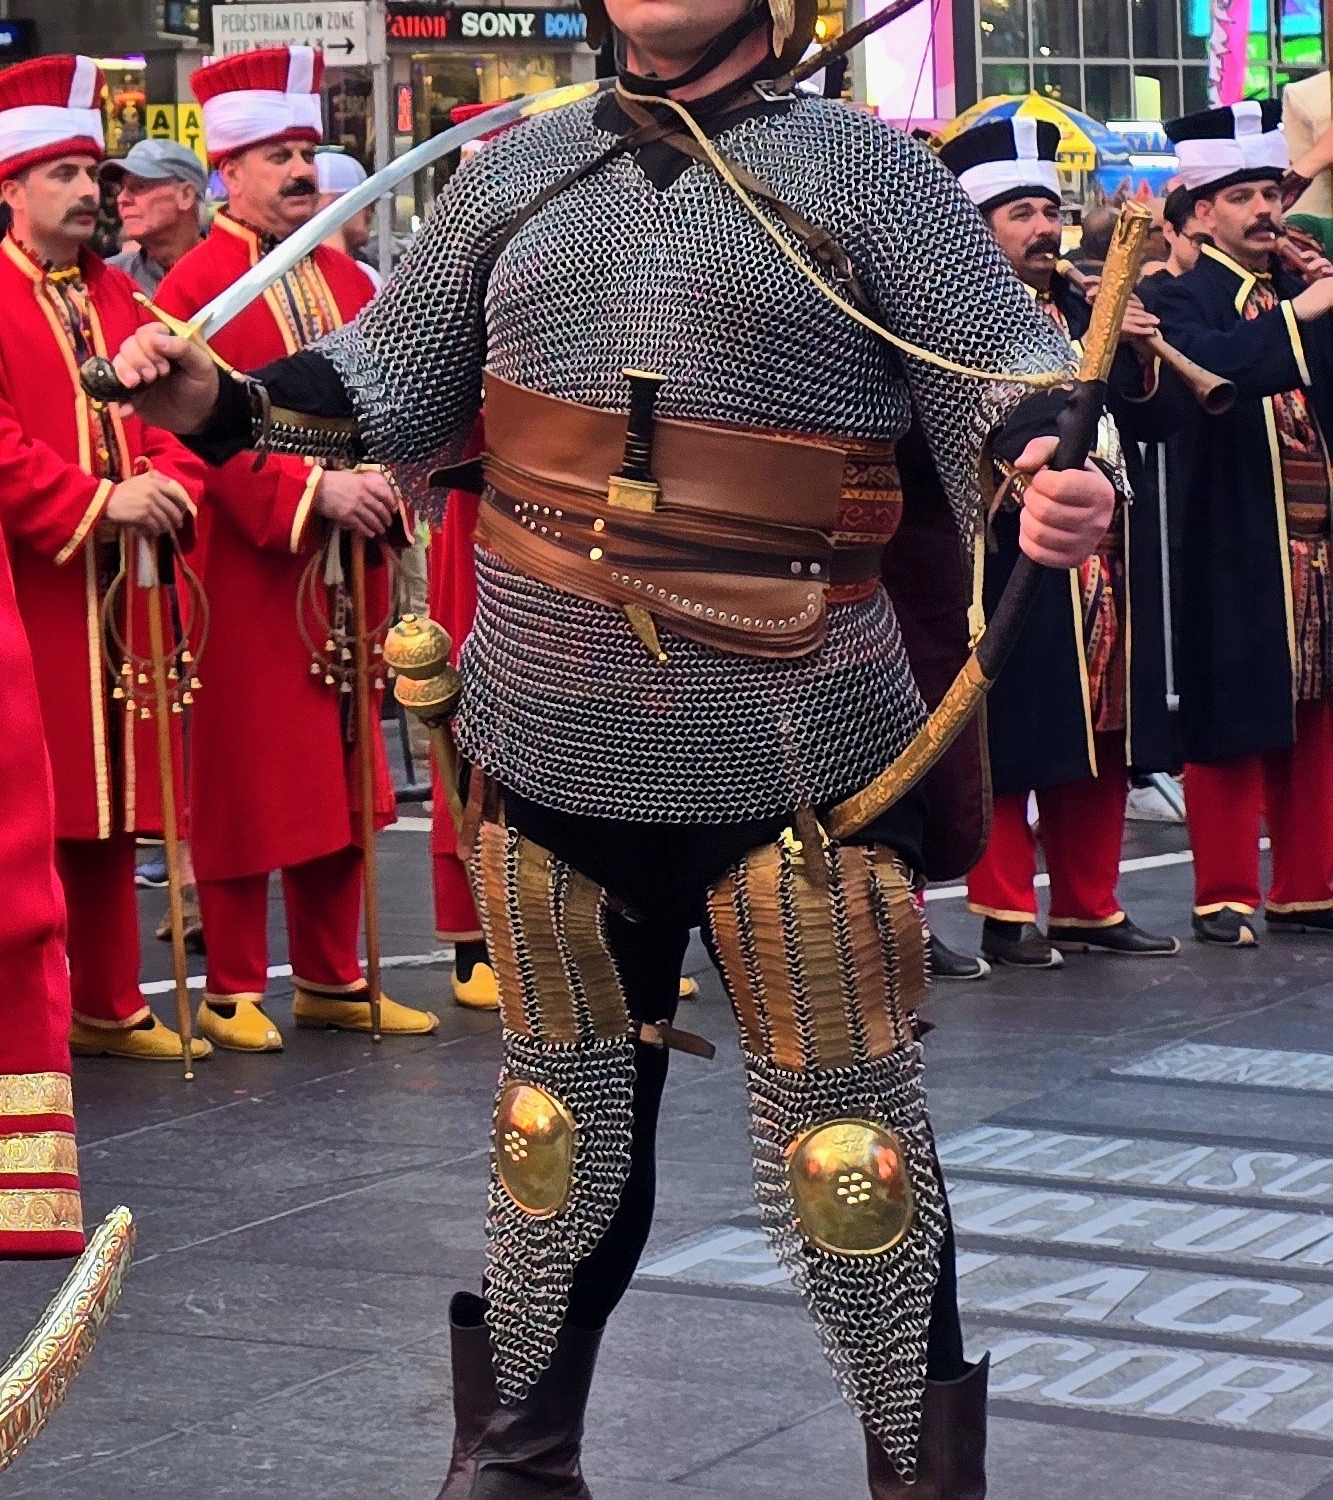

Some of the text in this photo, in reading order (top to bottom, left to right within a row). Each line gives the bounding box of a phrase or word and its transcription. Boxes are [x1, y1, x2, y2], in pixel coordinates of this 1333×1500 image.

[221, 10, 355, 33] PEDESTRIAN FLOW ZONE
[386, 12, 449, 39] anon
[461, 11, 535, 38] SONY
